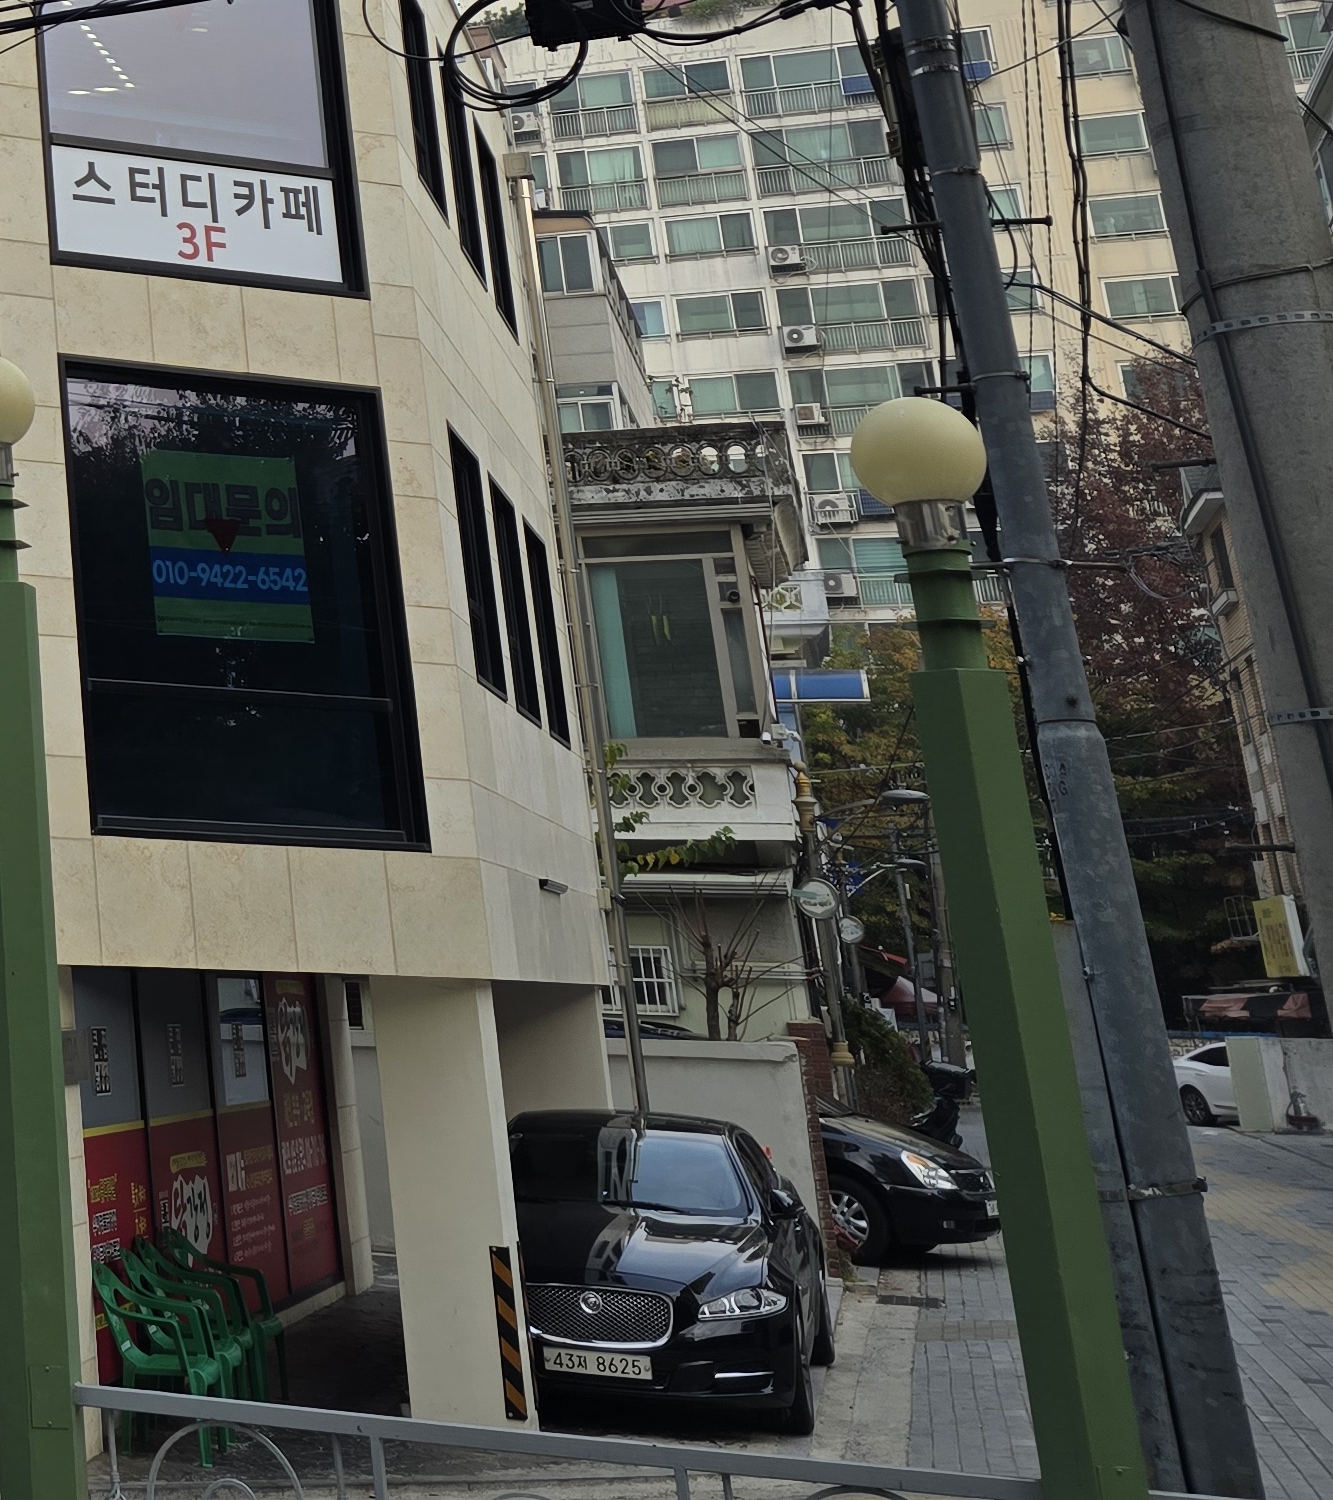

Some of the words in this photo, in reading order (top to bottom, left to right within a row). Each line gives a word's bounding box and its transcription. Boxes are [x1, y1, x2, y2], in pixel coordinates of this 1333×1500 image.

[72, 161, 323, 236] 스터디카페
[176, 222, 228, 262] 3F
[145, 478, 301, 538] 임대문의
[152, 559, 308, 592] 010-9422-6542
[553, 1351, 588, 1371] 43저
[595, 1355, 642, 1377] 8625
